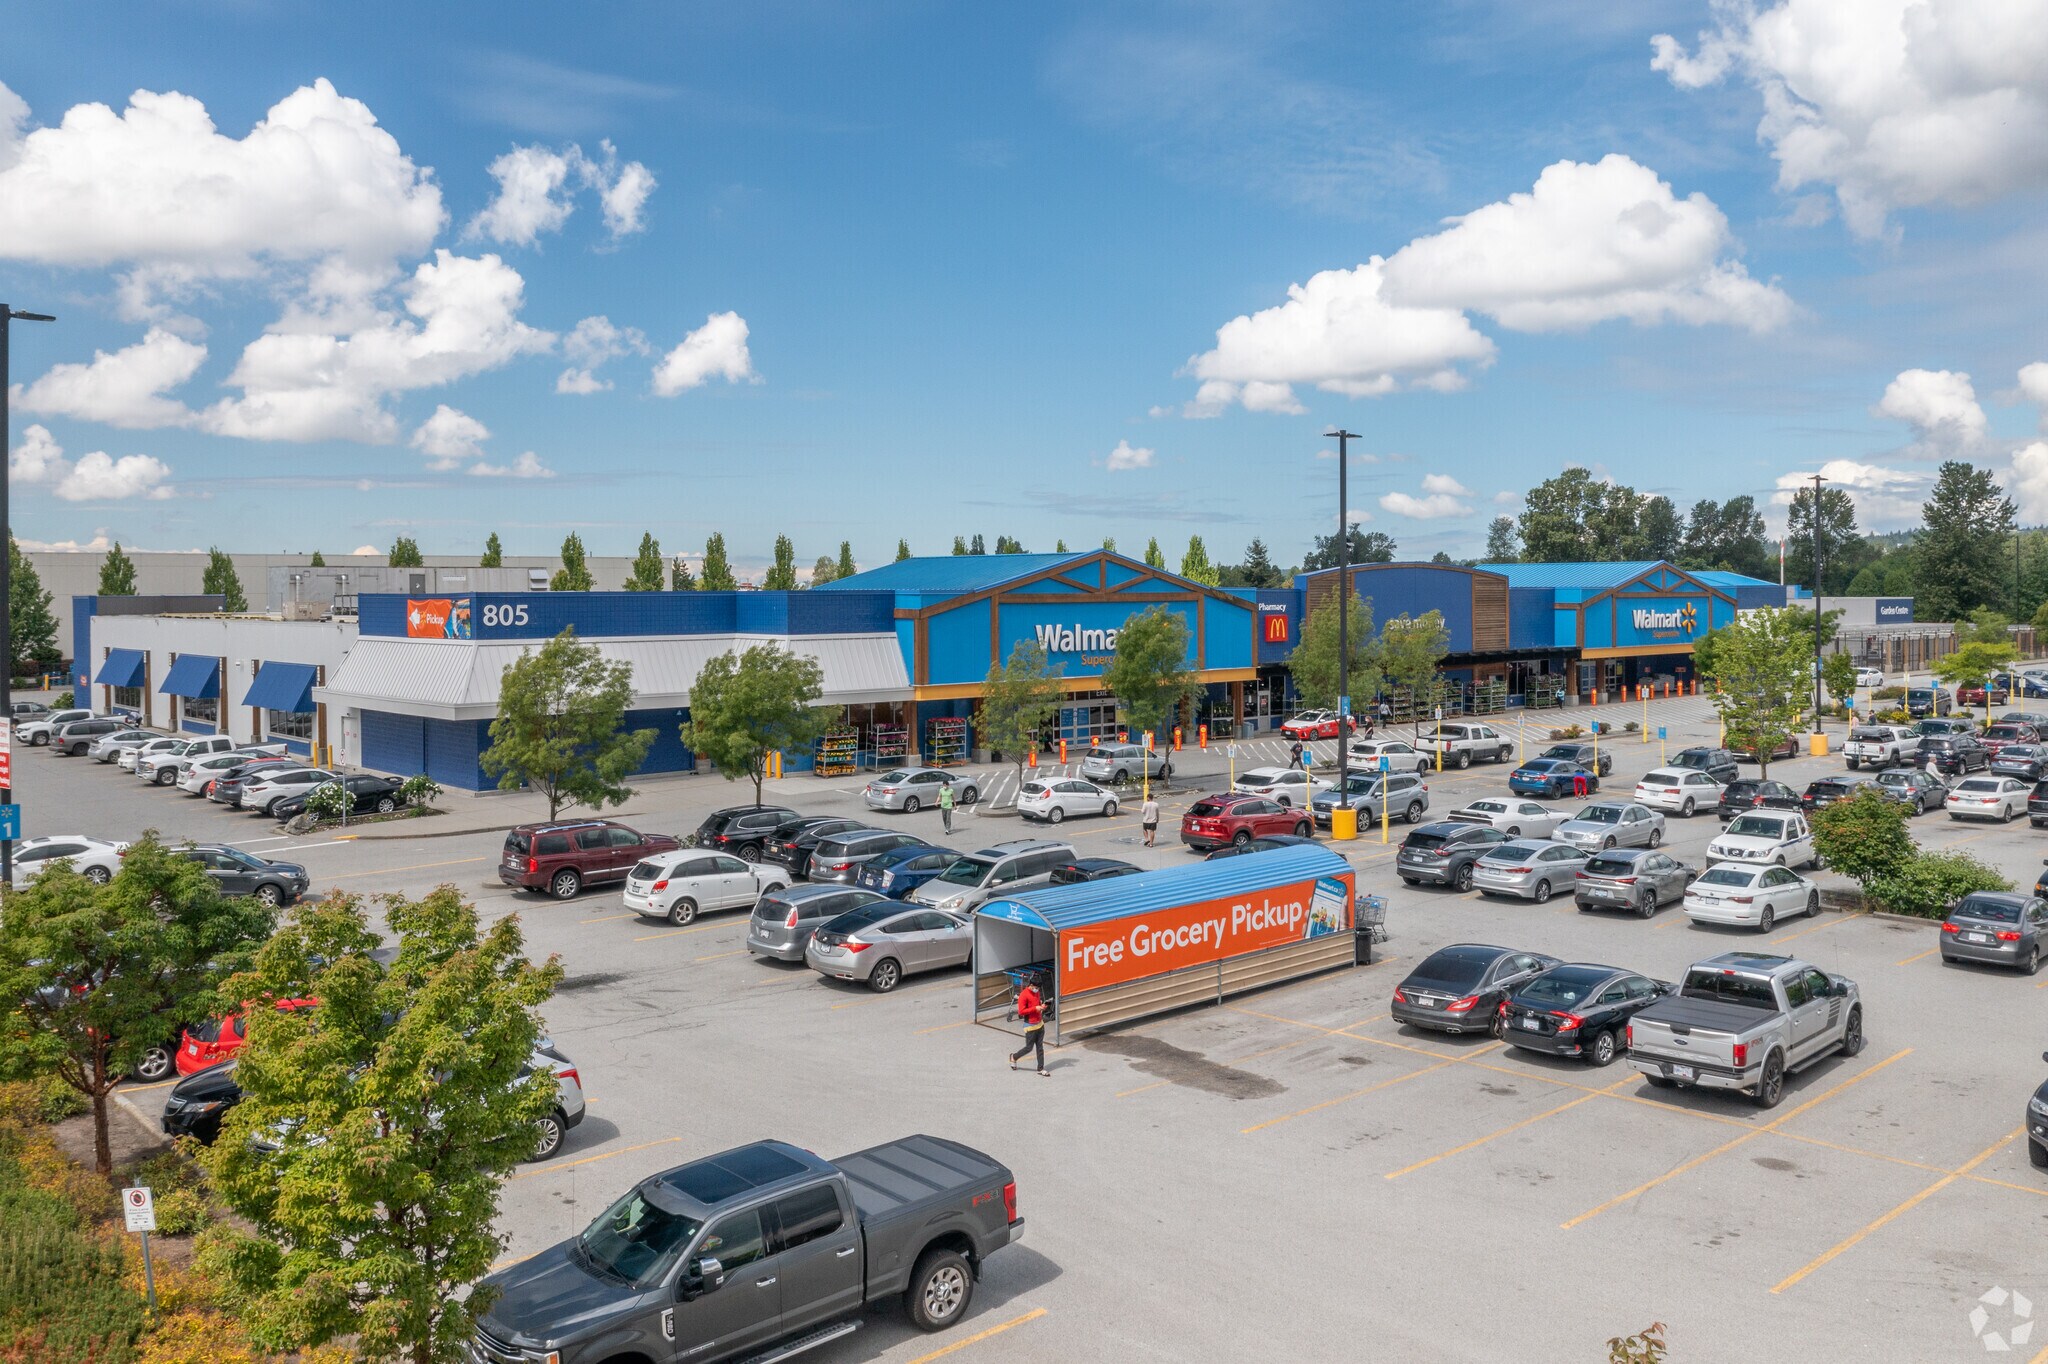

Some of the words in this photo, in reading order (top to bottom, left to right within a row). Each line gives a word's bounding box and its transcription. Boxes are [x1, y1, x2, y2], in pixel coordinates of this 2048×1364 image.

[483, 604, 529, 626] 805
[1259, 603, 1286, 612] Pharmacy
[426, 613, 444, 626] Pickup
[1632, 609, 1681, 628] Walmart
[1035, 623, 1124, 652] Walma
[1081, 653, 1116, 667] Superc
[1343, 706, 1349, 714] 2
[3, 822, 12, 838] 1
[1129, 917, 1227, 957] Grocery
[1232, 899, 1302, 936] Pickup
